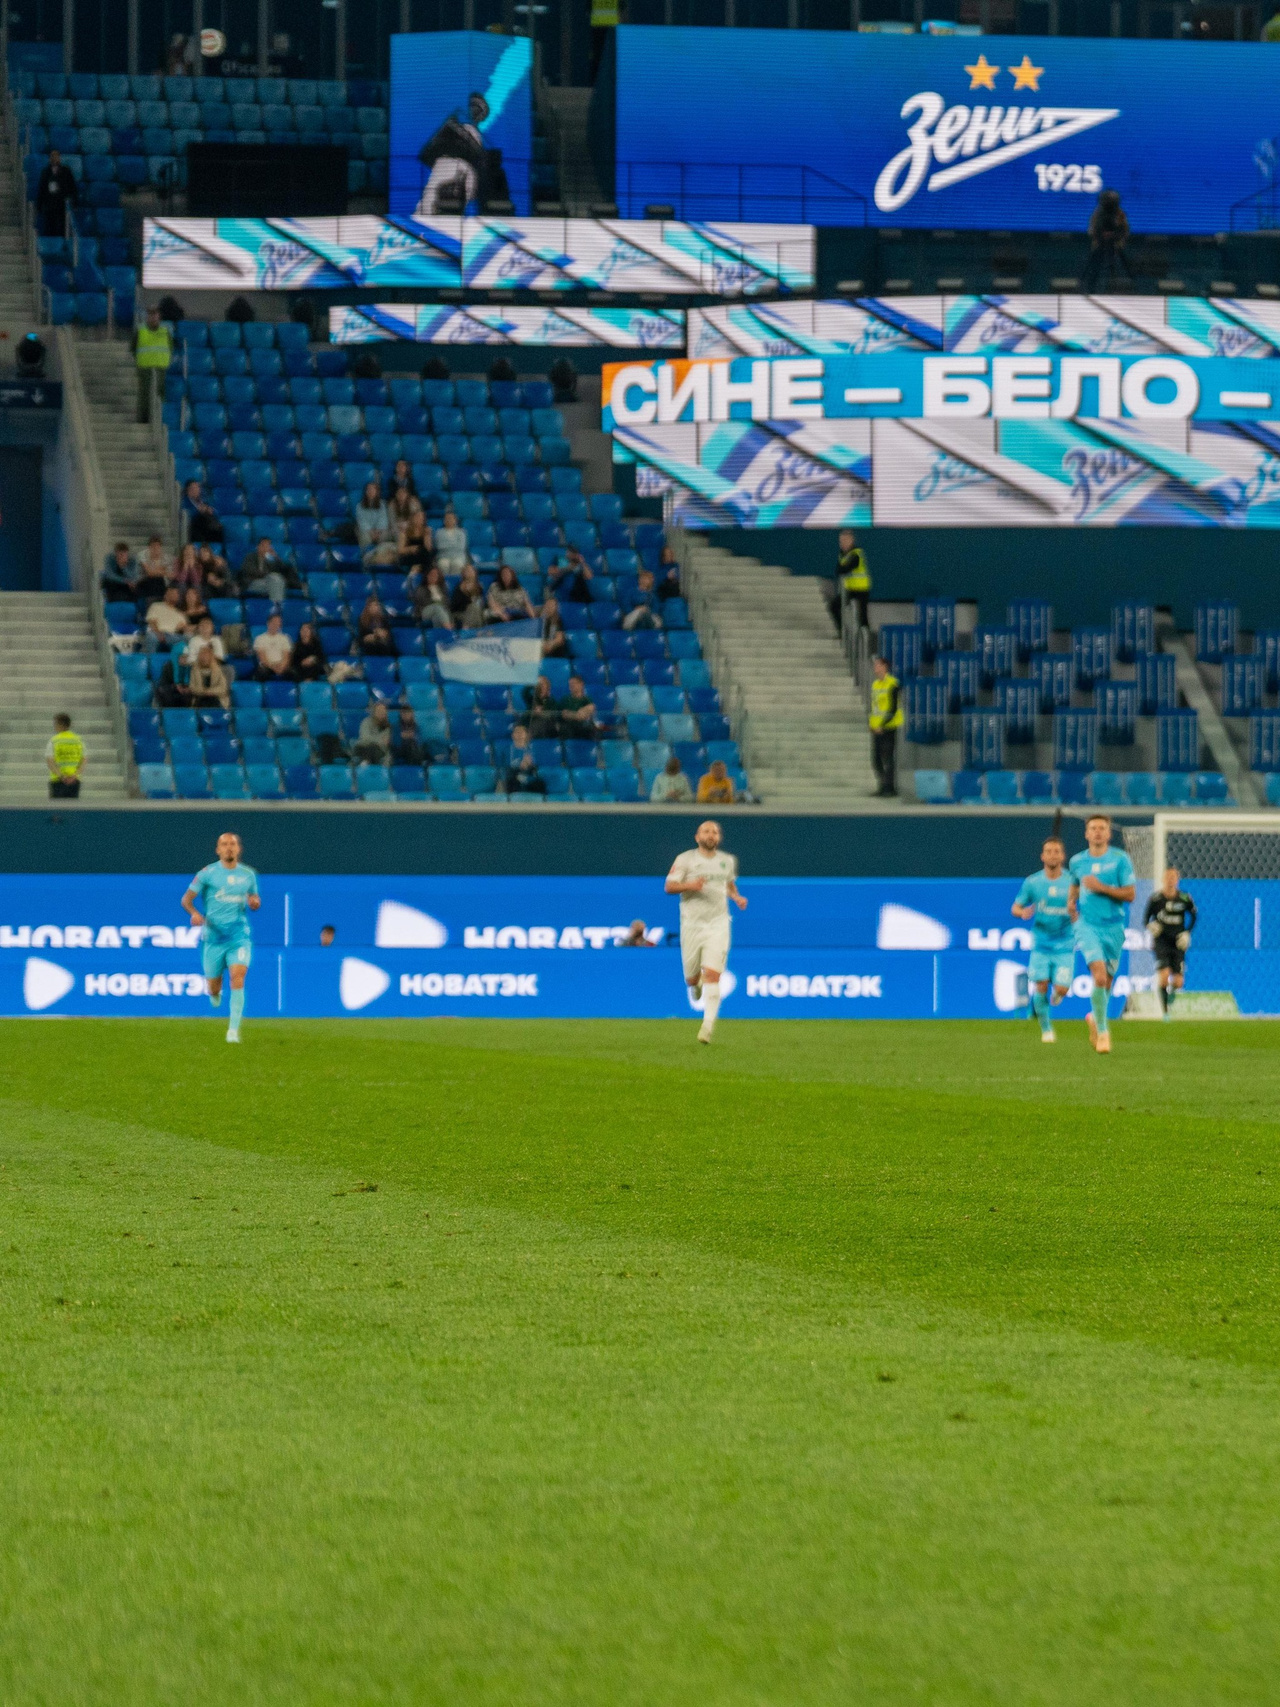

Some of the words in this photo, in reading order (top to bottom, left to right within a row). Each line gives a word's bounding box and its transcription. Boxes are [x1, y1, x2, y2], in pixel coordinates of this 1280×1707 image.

[874, 91, 1121, 213] Зенит
[1034, 164, 1104, 193] 1925
[611, 359, 824, 426] СИНЕ
[923, 356, 1199, 419] БЕЛО
[399, 973, 538, 997] НОВАТЭК
[746, 974, 882, 998] НОВАТЭК
